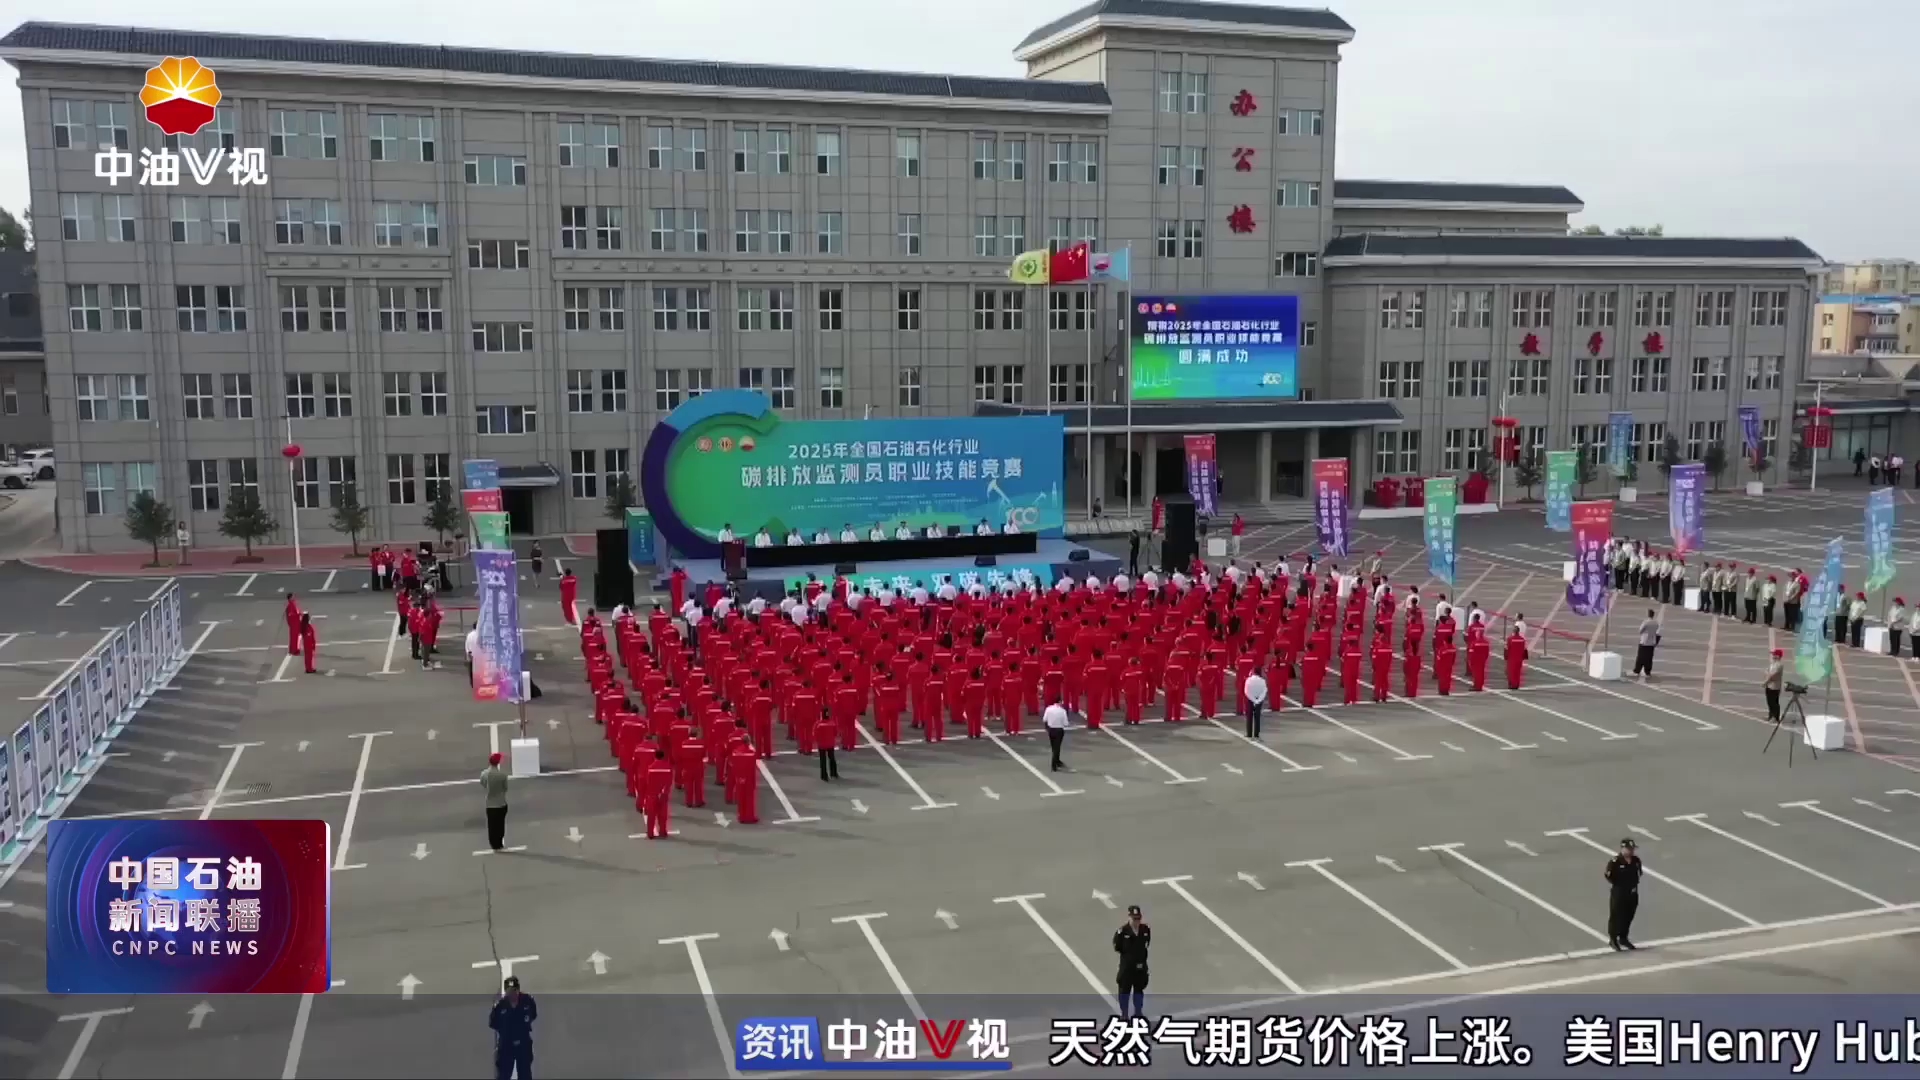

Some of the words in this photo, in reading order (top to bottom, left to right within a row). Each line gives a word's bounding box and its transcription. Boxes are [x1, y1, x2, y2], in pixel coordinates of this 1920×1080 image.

[1178, 349, 1249, 364] 圆满成功
[788, 438, 980, 459] 2025年全国石油石化行业
[740, 456, 1023, 488] 碳排放监测员职业技能竞赛
